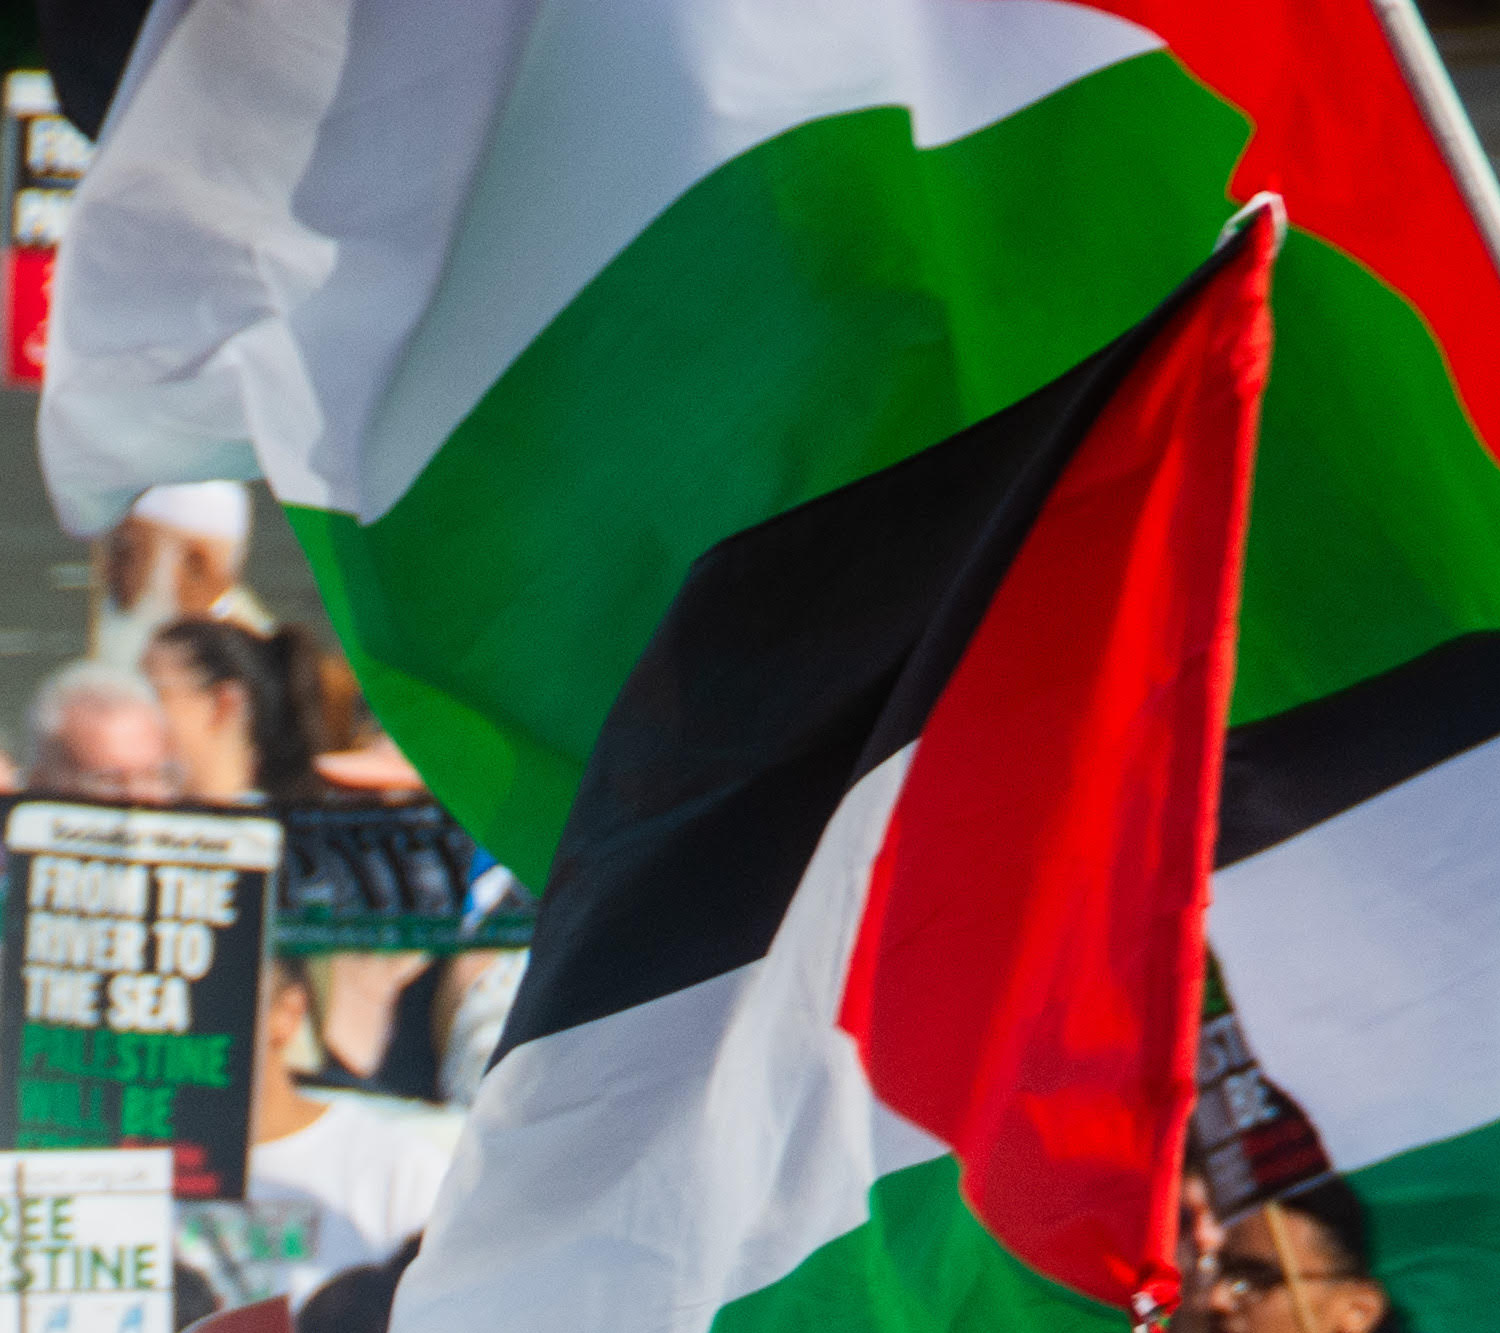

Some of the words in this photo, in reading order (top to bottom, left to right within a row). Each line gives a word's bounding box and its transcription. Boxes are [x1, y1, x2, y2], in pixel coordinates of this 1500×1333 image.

[28, 854, 150, 918] FROM
[152, 866, 237, 928] THE
[24, 911, 147, 974] RIVER
[151, 919, 213, 981] TO
[22, 967, 100, 1029] THE
[107, 974, 192, 1036] SEA
[22, 1020, 234, 1088] PALESTINE
[121, 1084, 174, 1138] BE
